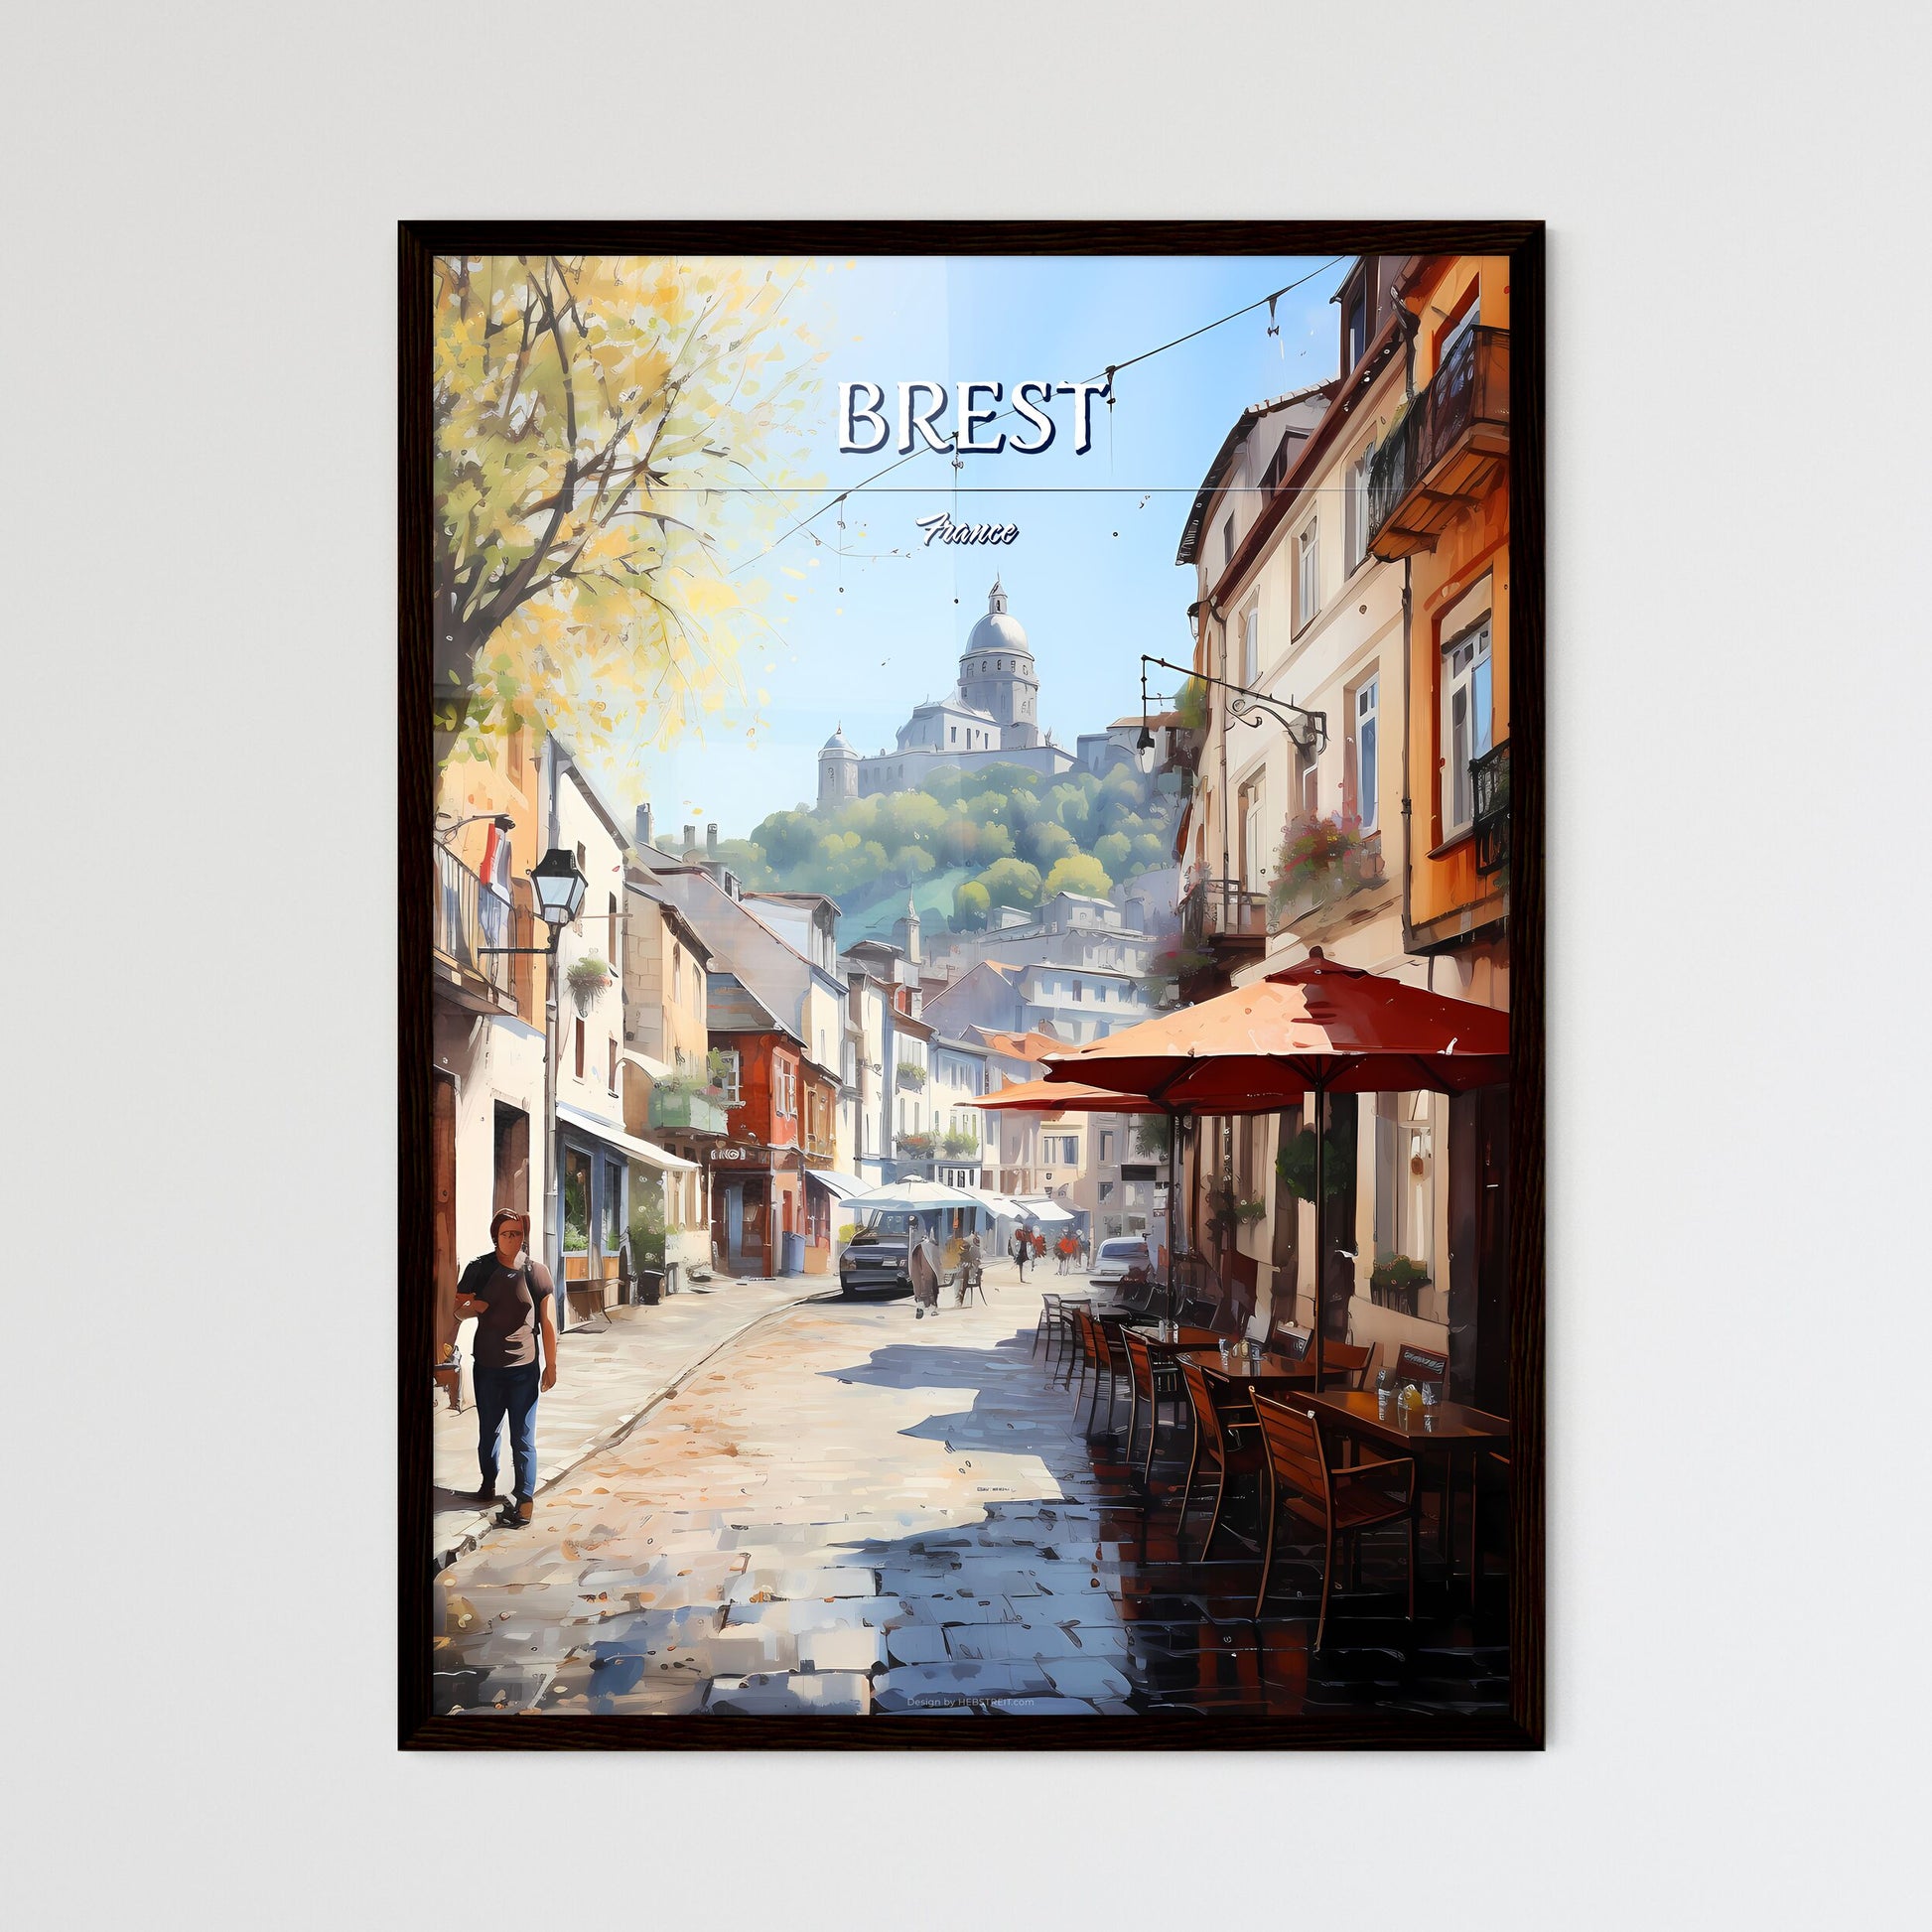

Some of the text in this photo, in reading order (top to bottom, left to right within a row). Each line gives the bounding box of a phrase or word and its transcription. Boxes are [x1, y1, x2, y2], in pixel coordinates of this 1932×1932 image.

[838, 380, 1111, 455] BREST
[915, 511, 1020, 546] France
[907, 1698, 1035, 1708] Design by HEBSTREIT.com
